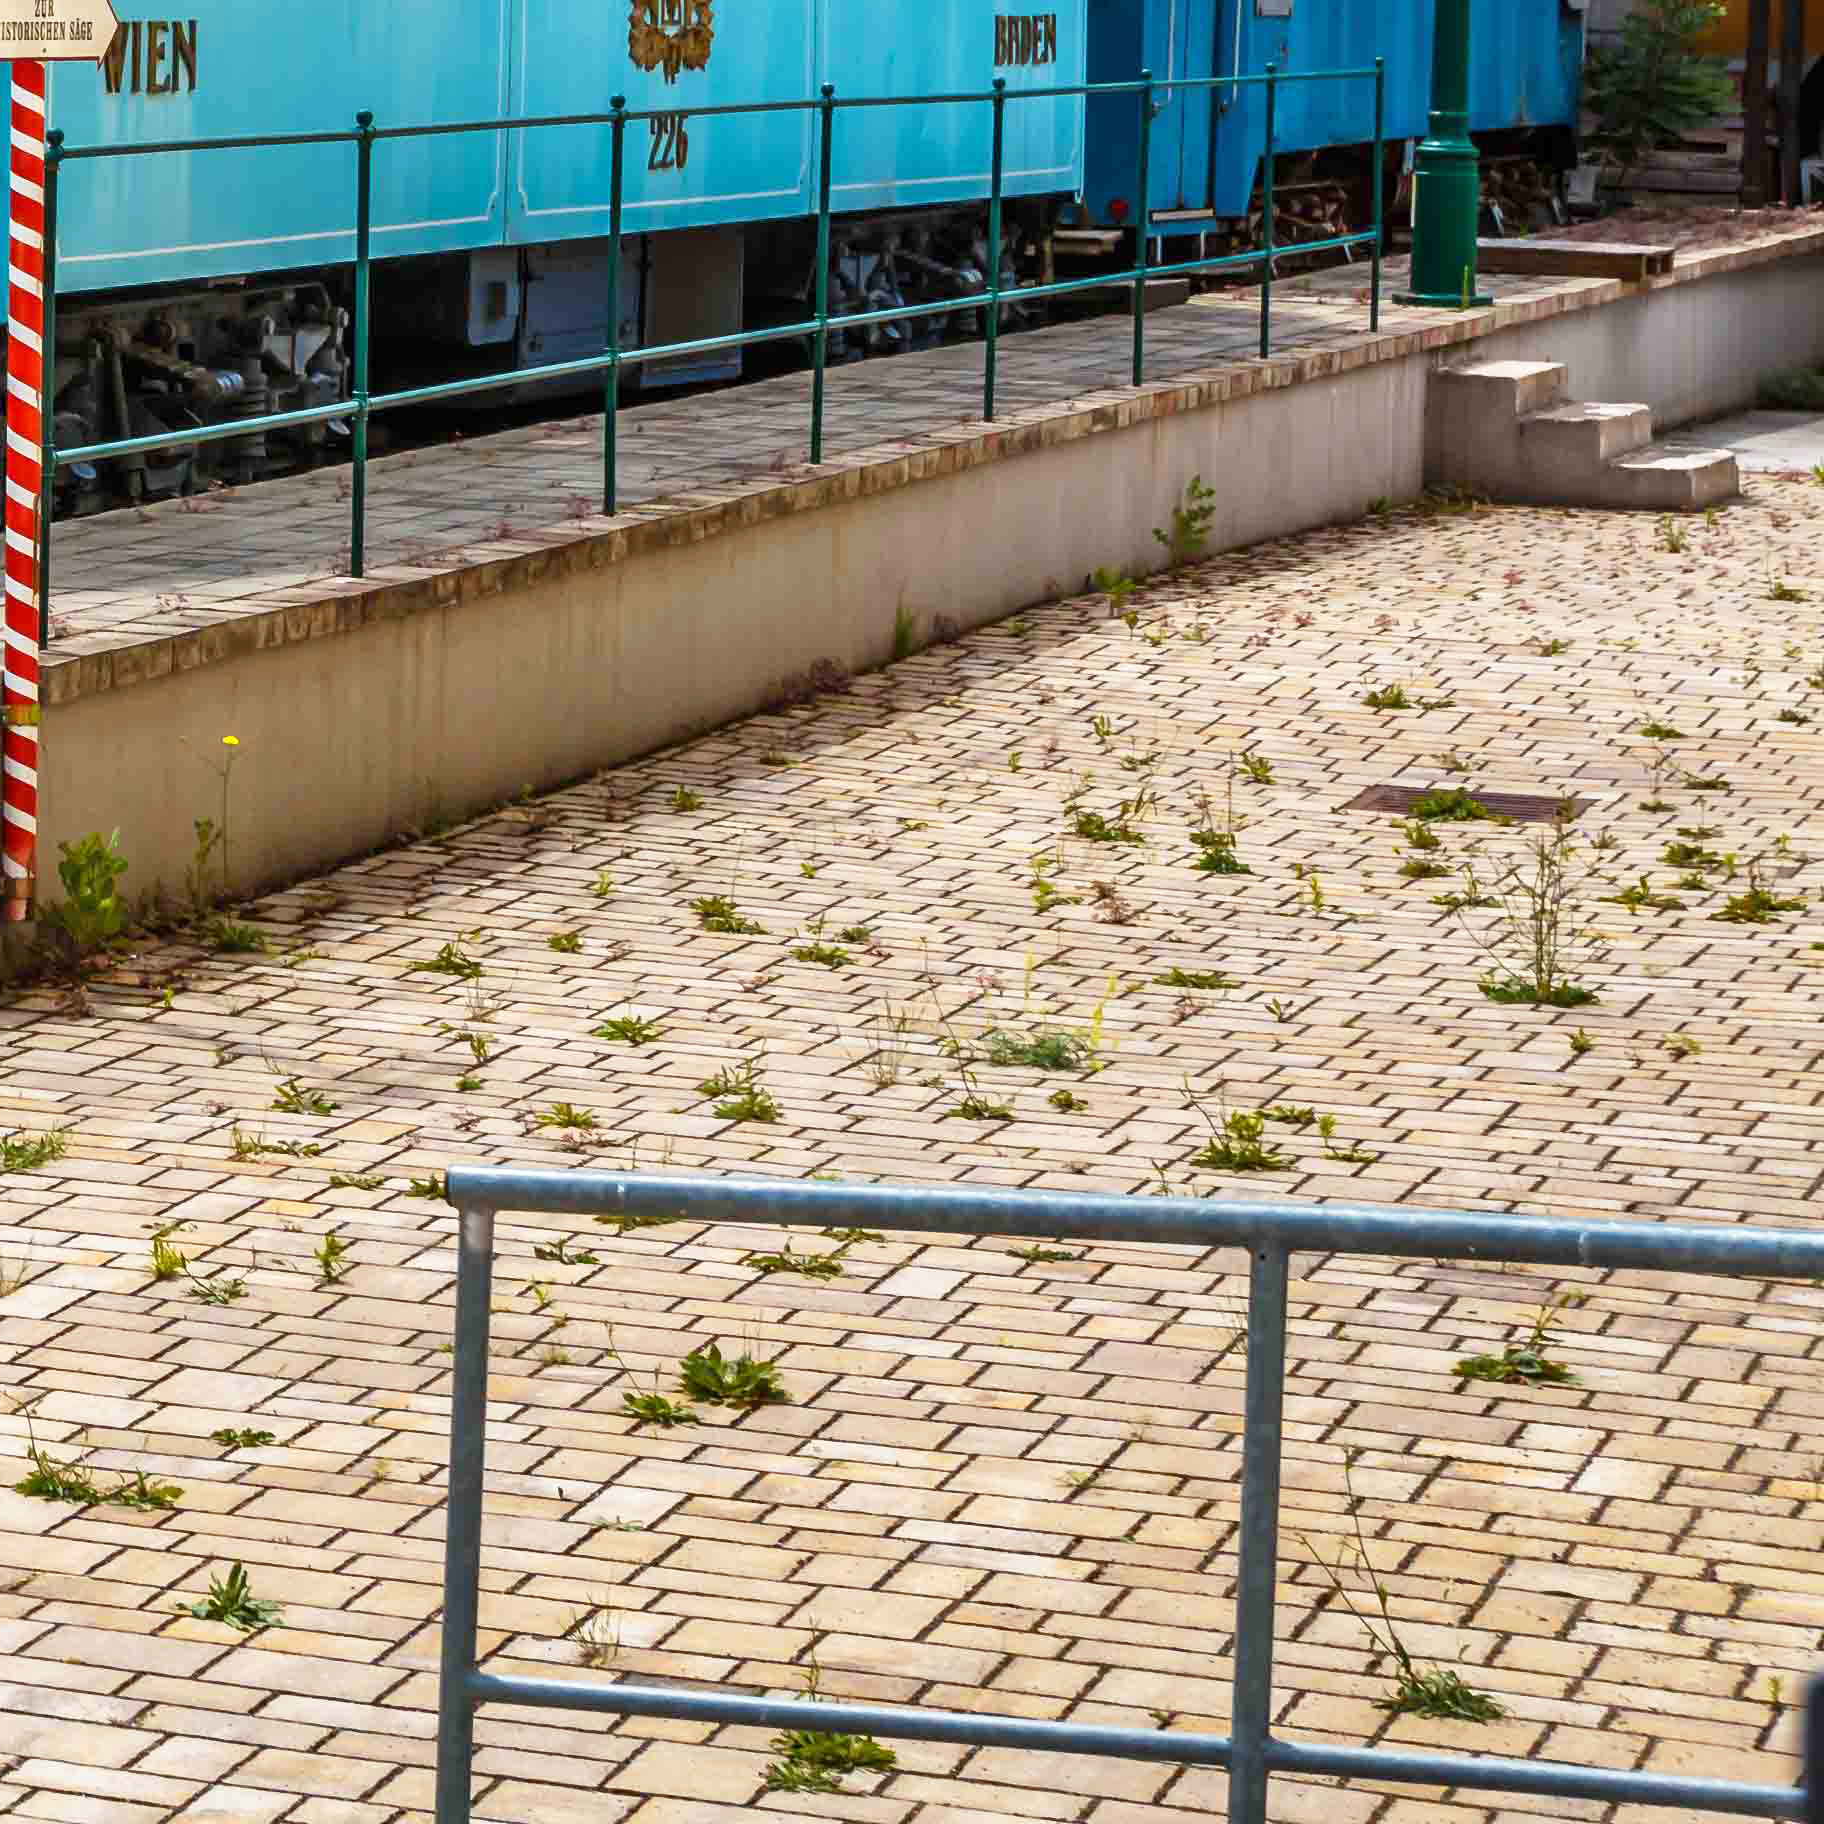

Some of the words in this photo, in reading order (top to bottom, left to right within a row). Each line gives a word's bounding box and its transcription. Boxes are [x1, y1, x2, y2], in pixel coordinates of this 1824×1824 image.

[69, 17, 94, 42] SÄGE
[993, 13, 1057, 66] BADEN
[648, 112, 689, 171] 226
